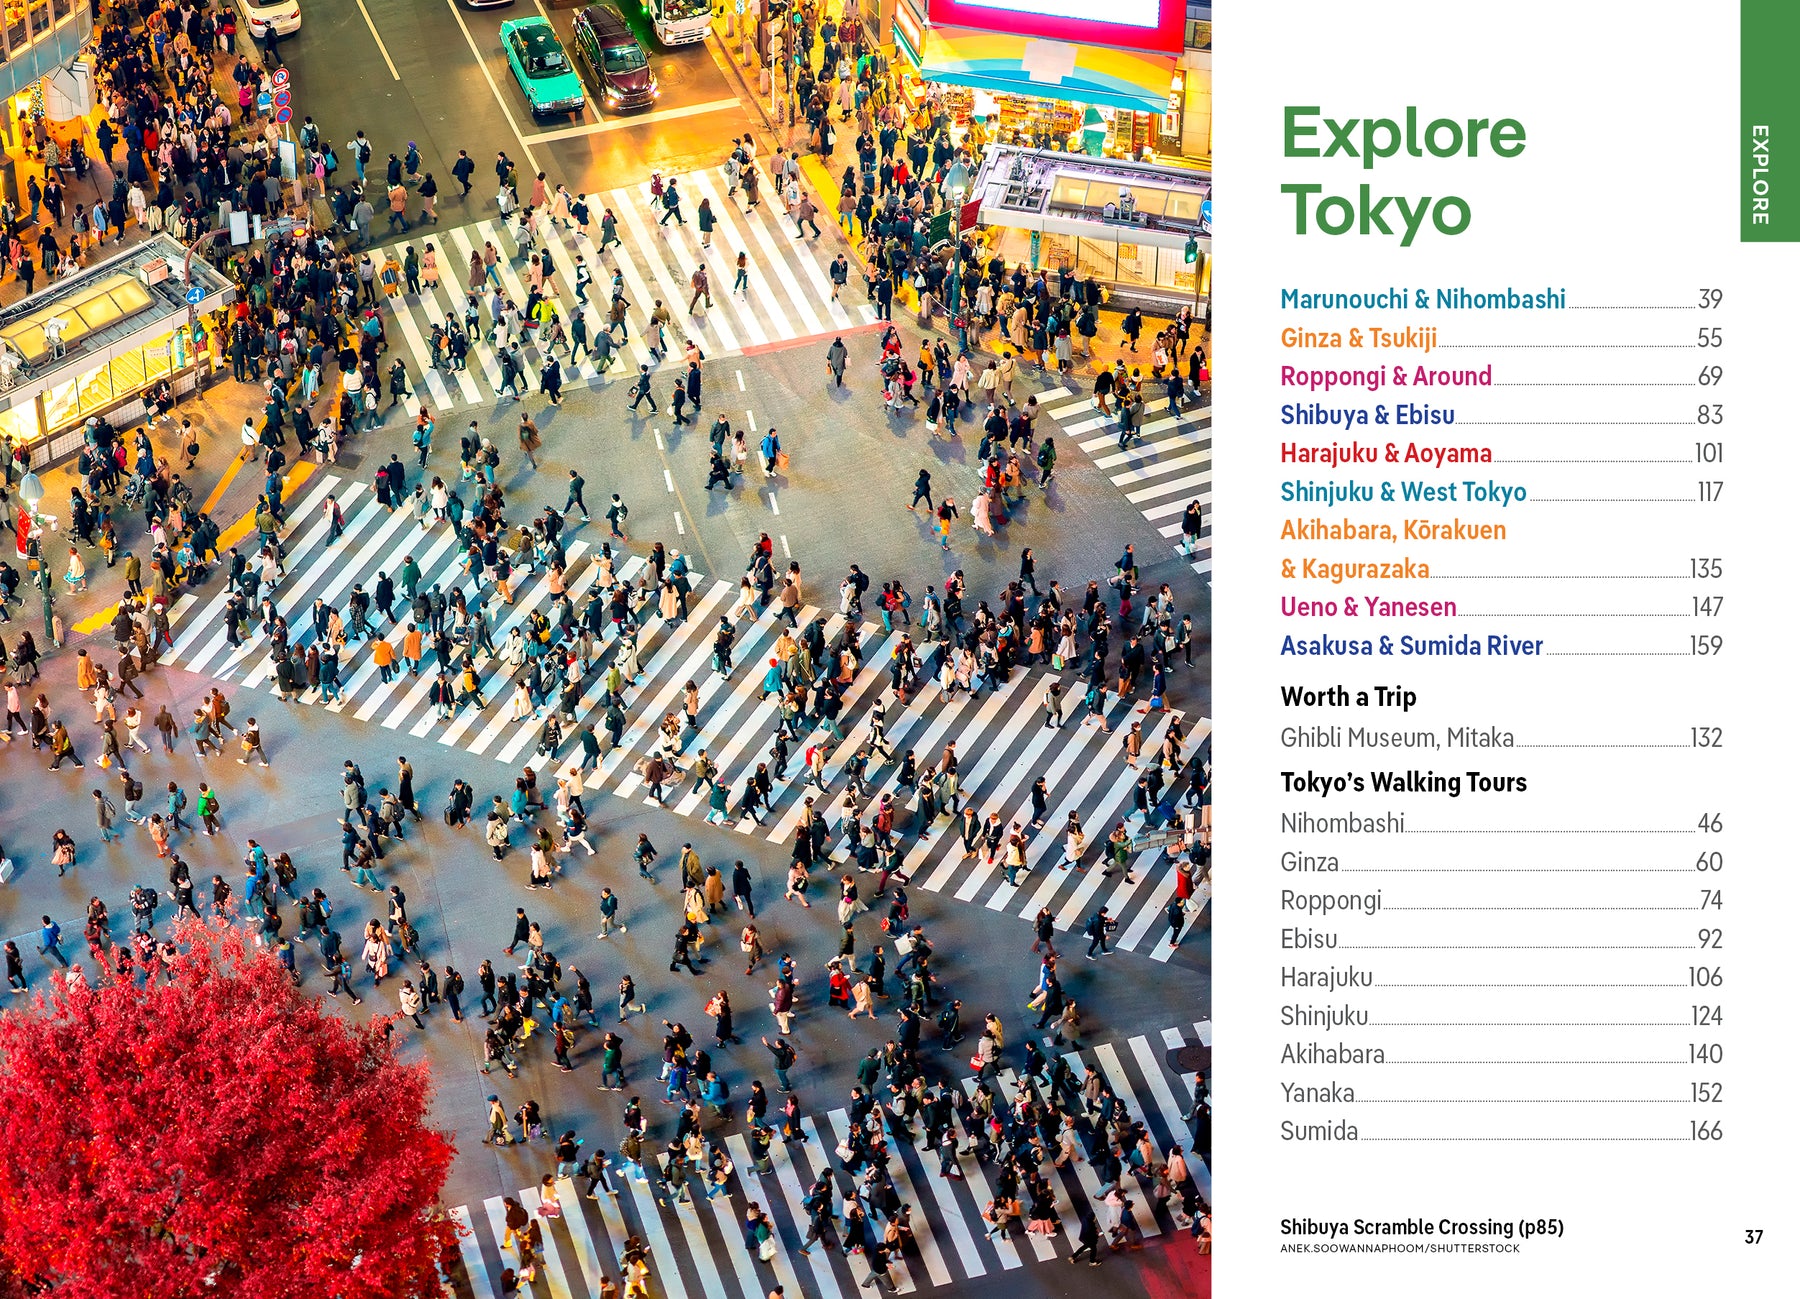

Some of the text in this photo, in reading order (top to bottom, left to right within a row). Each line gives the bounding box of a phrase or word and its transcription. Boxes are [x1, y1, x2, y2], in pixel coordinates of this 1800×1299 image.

[1284, 106, 1526, 169] Explore
[1753, 126, 1768, 224] EXPLORE
[1281, 184, 1471, 247] Tokyo
[1282, 287, 1722, 309] Marunouchi & Nihombashi 39
[1281, 326, 1722, 353] Ginza & Tsukiji 55
[1282, 364, 1722, 391] Roppongi & Around 69
[1281, 403, 1723, 430] Shibuya & Ebisu 83
[1282, 441, 1722, 468] Harajuku & Aoyama 101
[1281, 480, 1723, 507] Shinjuku & West Tokyo 117
[1280, 518, 1506, 543] Akihabara, Kōrakuen
[1282, 557, 1722, 584] & Kagurazaka 135
[1282, 596, 1723, 616] Ueno & Yanesen 147
[1281, 634, 1722, 655] Asakusa & Sumida River 159
[1281, 685, 1416, 712] Worth a Trip
[1281, 726, 1722, 751] Ghibli Museum, Mitaka 132
[1371, 770, 1460, 797] Walking
[1466, 772, 1527, 792] Tours
[1282, 811, 1722, 833] Nihombashi 46
[1282, 851, 1722, 871] Ginza 60
[1282, 889, 1722, 915] Roppongi 74
[1282, 927, 1722, 948] Ebisu 92
[1282, 965, 1722, 992] Harajuku 106
[1281, 1004, 1723, 1031] Shinjuku 124
[1281, 1042, 1722, 1063] Akihabara 140
[1281, 1081, 1722, 1102] Yanaka 152
[1281, 1119, 1722, 1140] Sumida 166
[1281, 1218, 1563, 1239] Shibuya Scramble Crossing (p85)
[1745, 1230, 1763, 1244] 37
[1281, 1244, 1519, 1253] ANEK.SOOWANNAPHOOM/SHUTTERSTOCK
